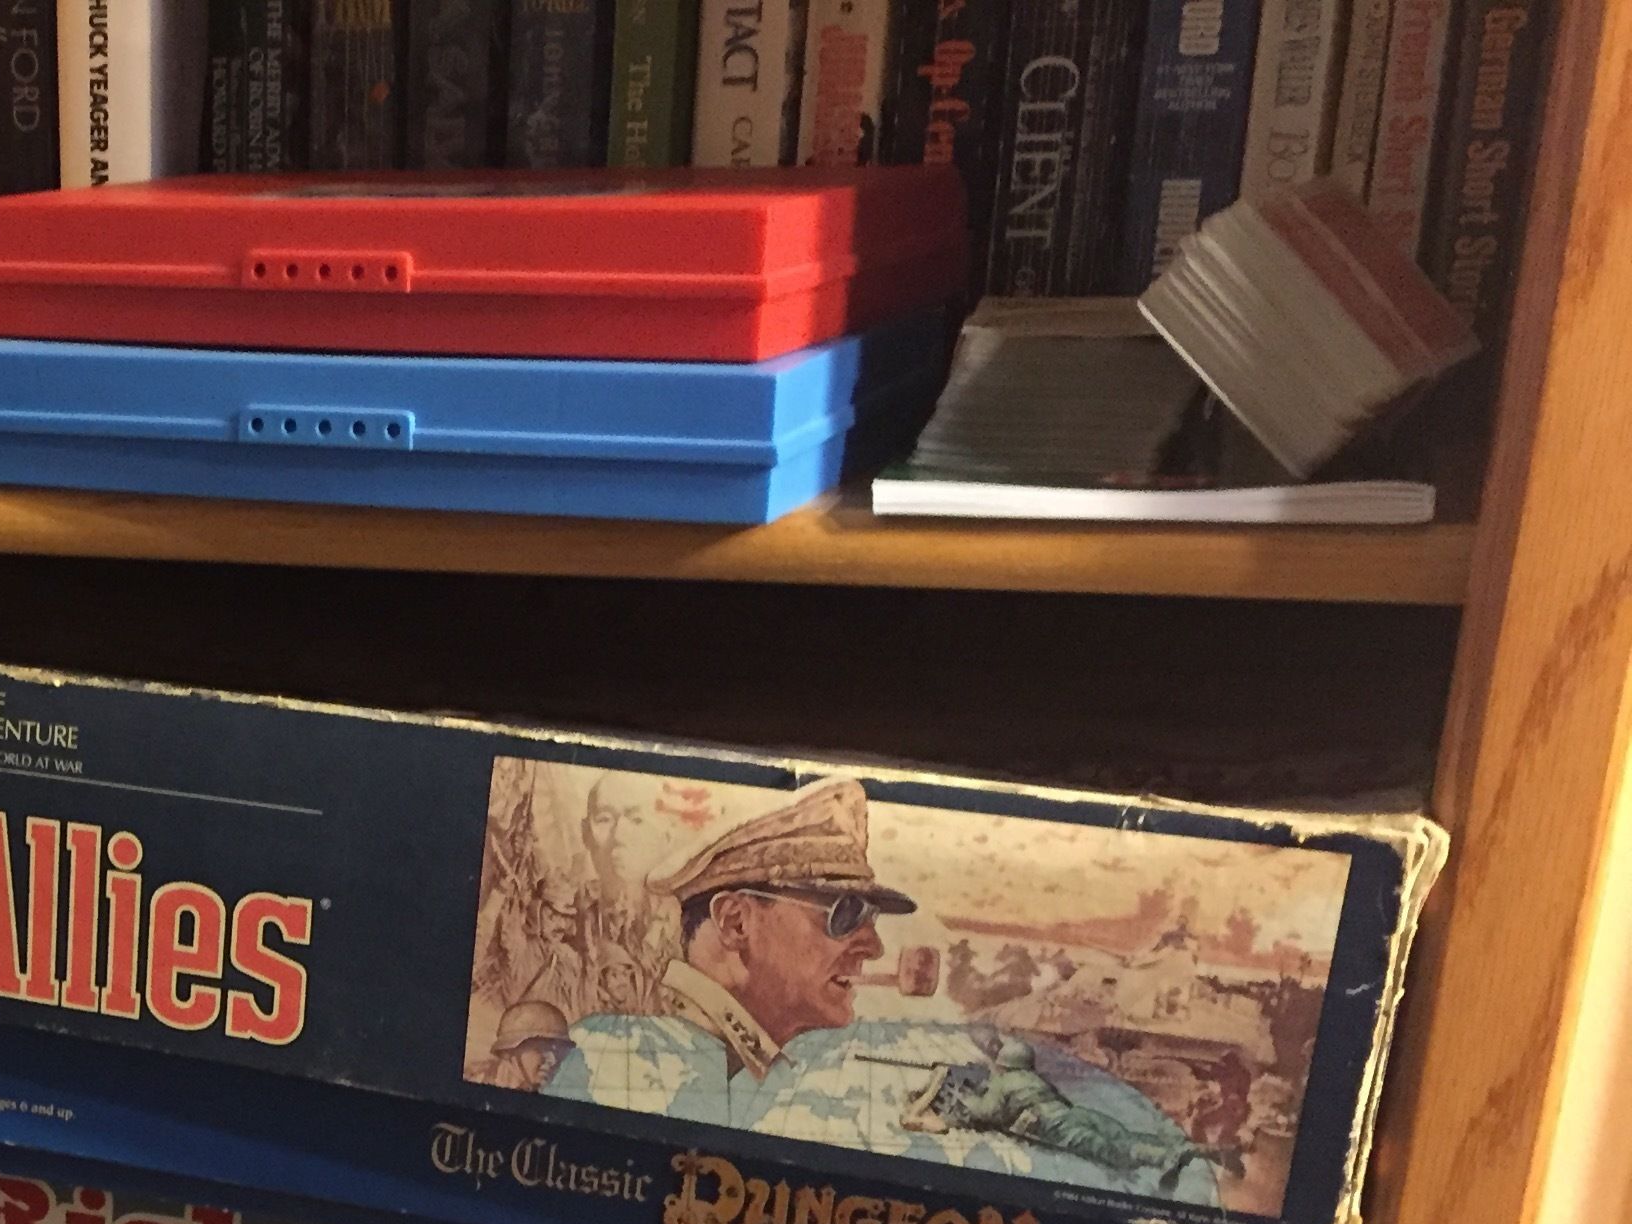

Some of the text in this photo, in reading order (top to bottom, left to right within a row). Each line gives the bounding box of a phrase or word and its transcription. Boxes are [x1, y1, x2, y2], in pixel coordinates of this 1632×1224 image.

[9, 29, 41, 133] FORD
[88, 64, 110, 153] YEAGER
[211, 56, 228, 152] HOWARD
[247, 81, 264, 147] ROBIN
[266, 47, 283, 119] MERRY
[626, 55, 653, 117] The
[1458, 8, 1529, 226] German Short
[1005, 55, 1080, 249] CLIENT
[35, 755, 51, 771] AT
[53, 758, 85, 776] WAR
[31, 1099, 55, 1117] and
[428, 1122, 505, 1190] The
[510, 1136, 654, 1203] Classic
